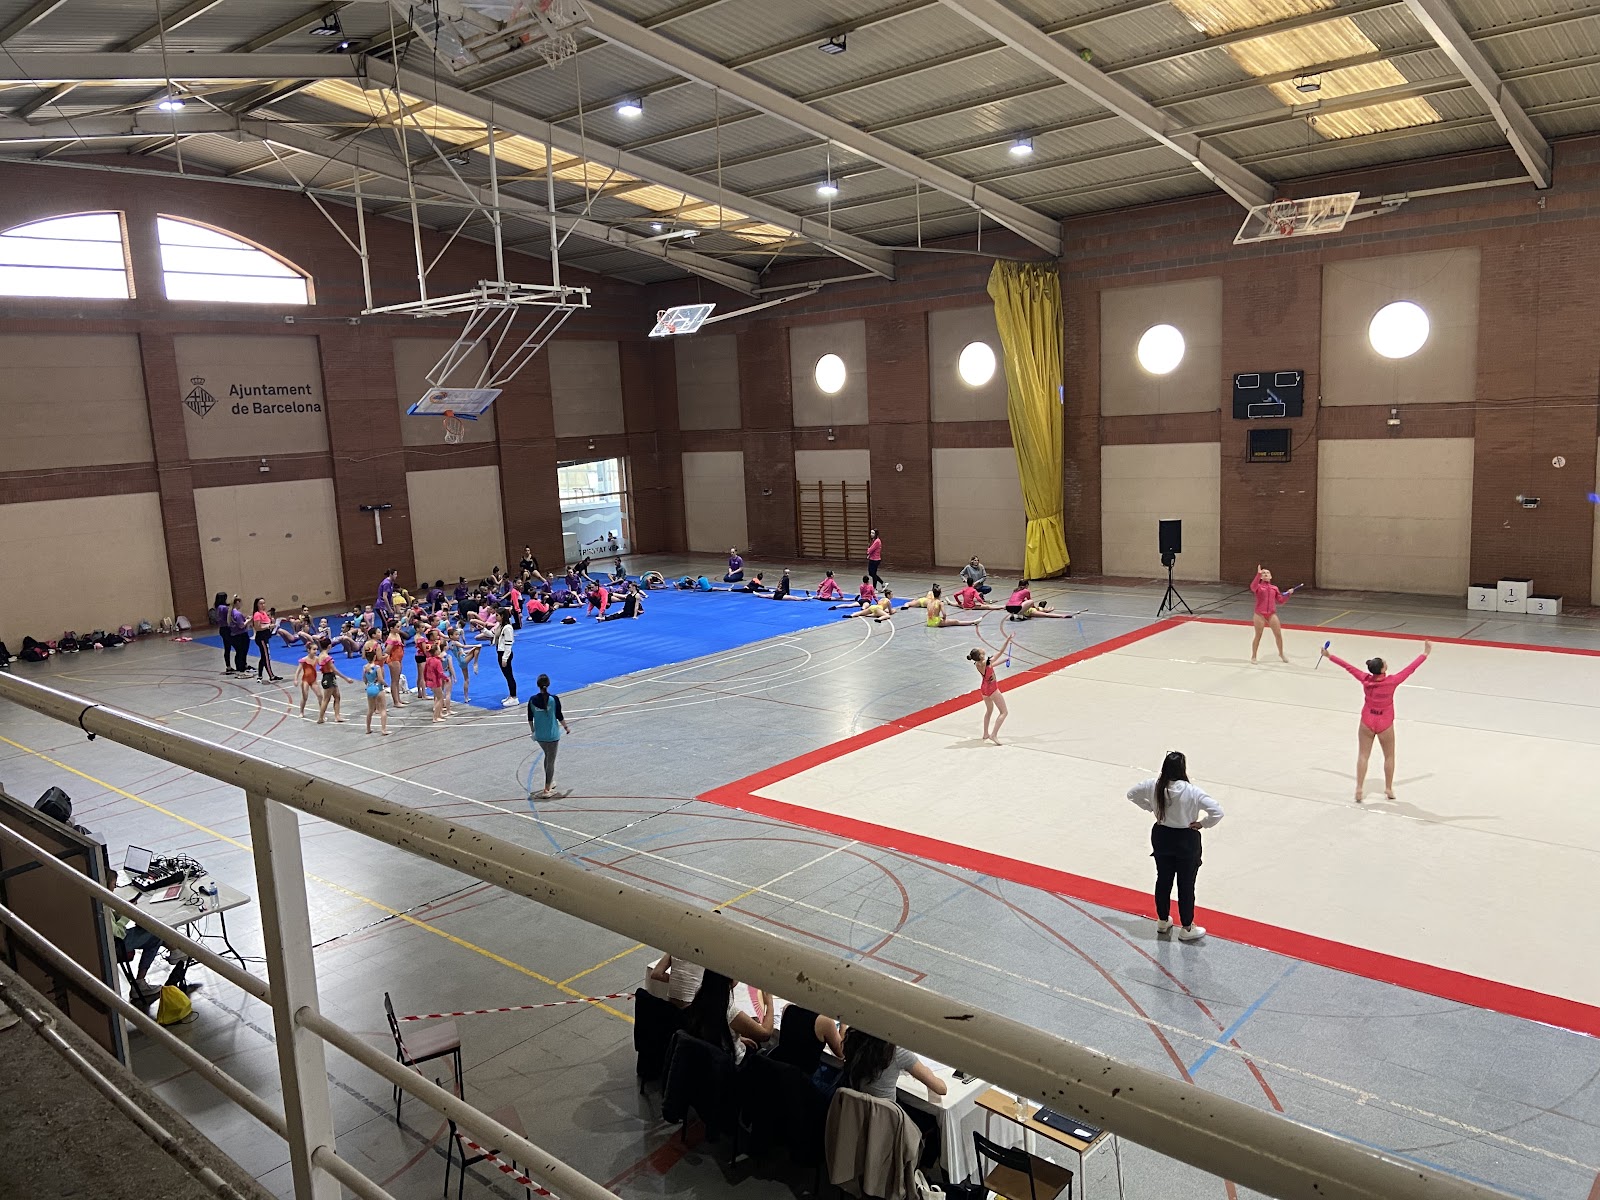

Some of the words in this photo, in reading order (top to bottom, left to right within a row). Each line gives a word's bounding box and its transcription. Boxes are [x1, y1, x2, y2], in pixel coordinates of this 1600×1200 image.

[229, 384, 312, 399] Ajuntament
[231, 403, 249, 415] de
[252, 402, 322, 415] Barcelona
[1508, 588, 1514, 597] 1
[1480, 594, 1486, 602] 2
[1537, 602, 1544, 611] 3
